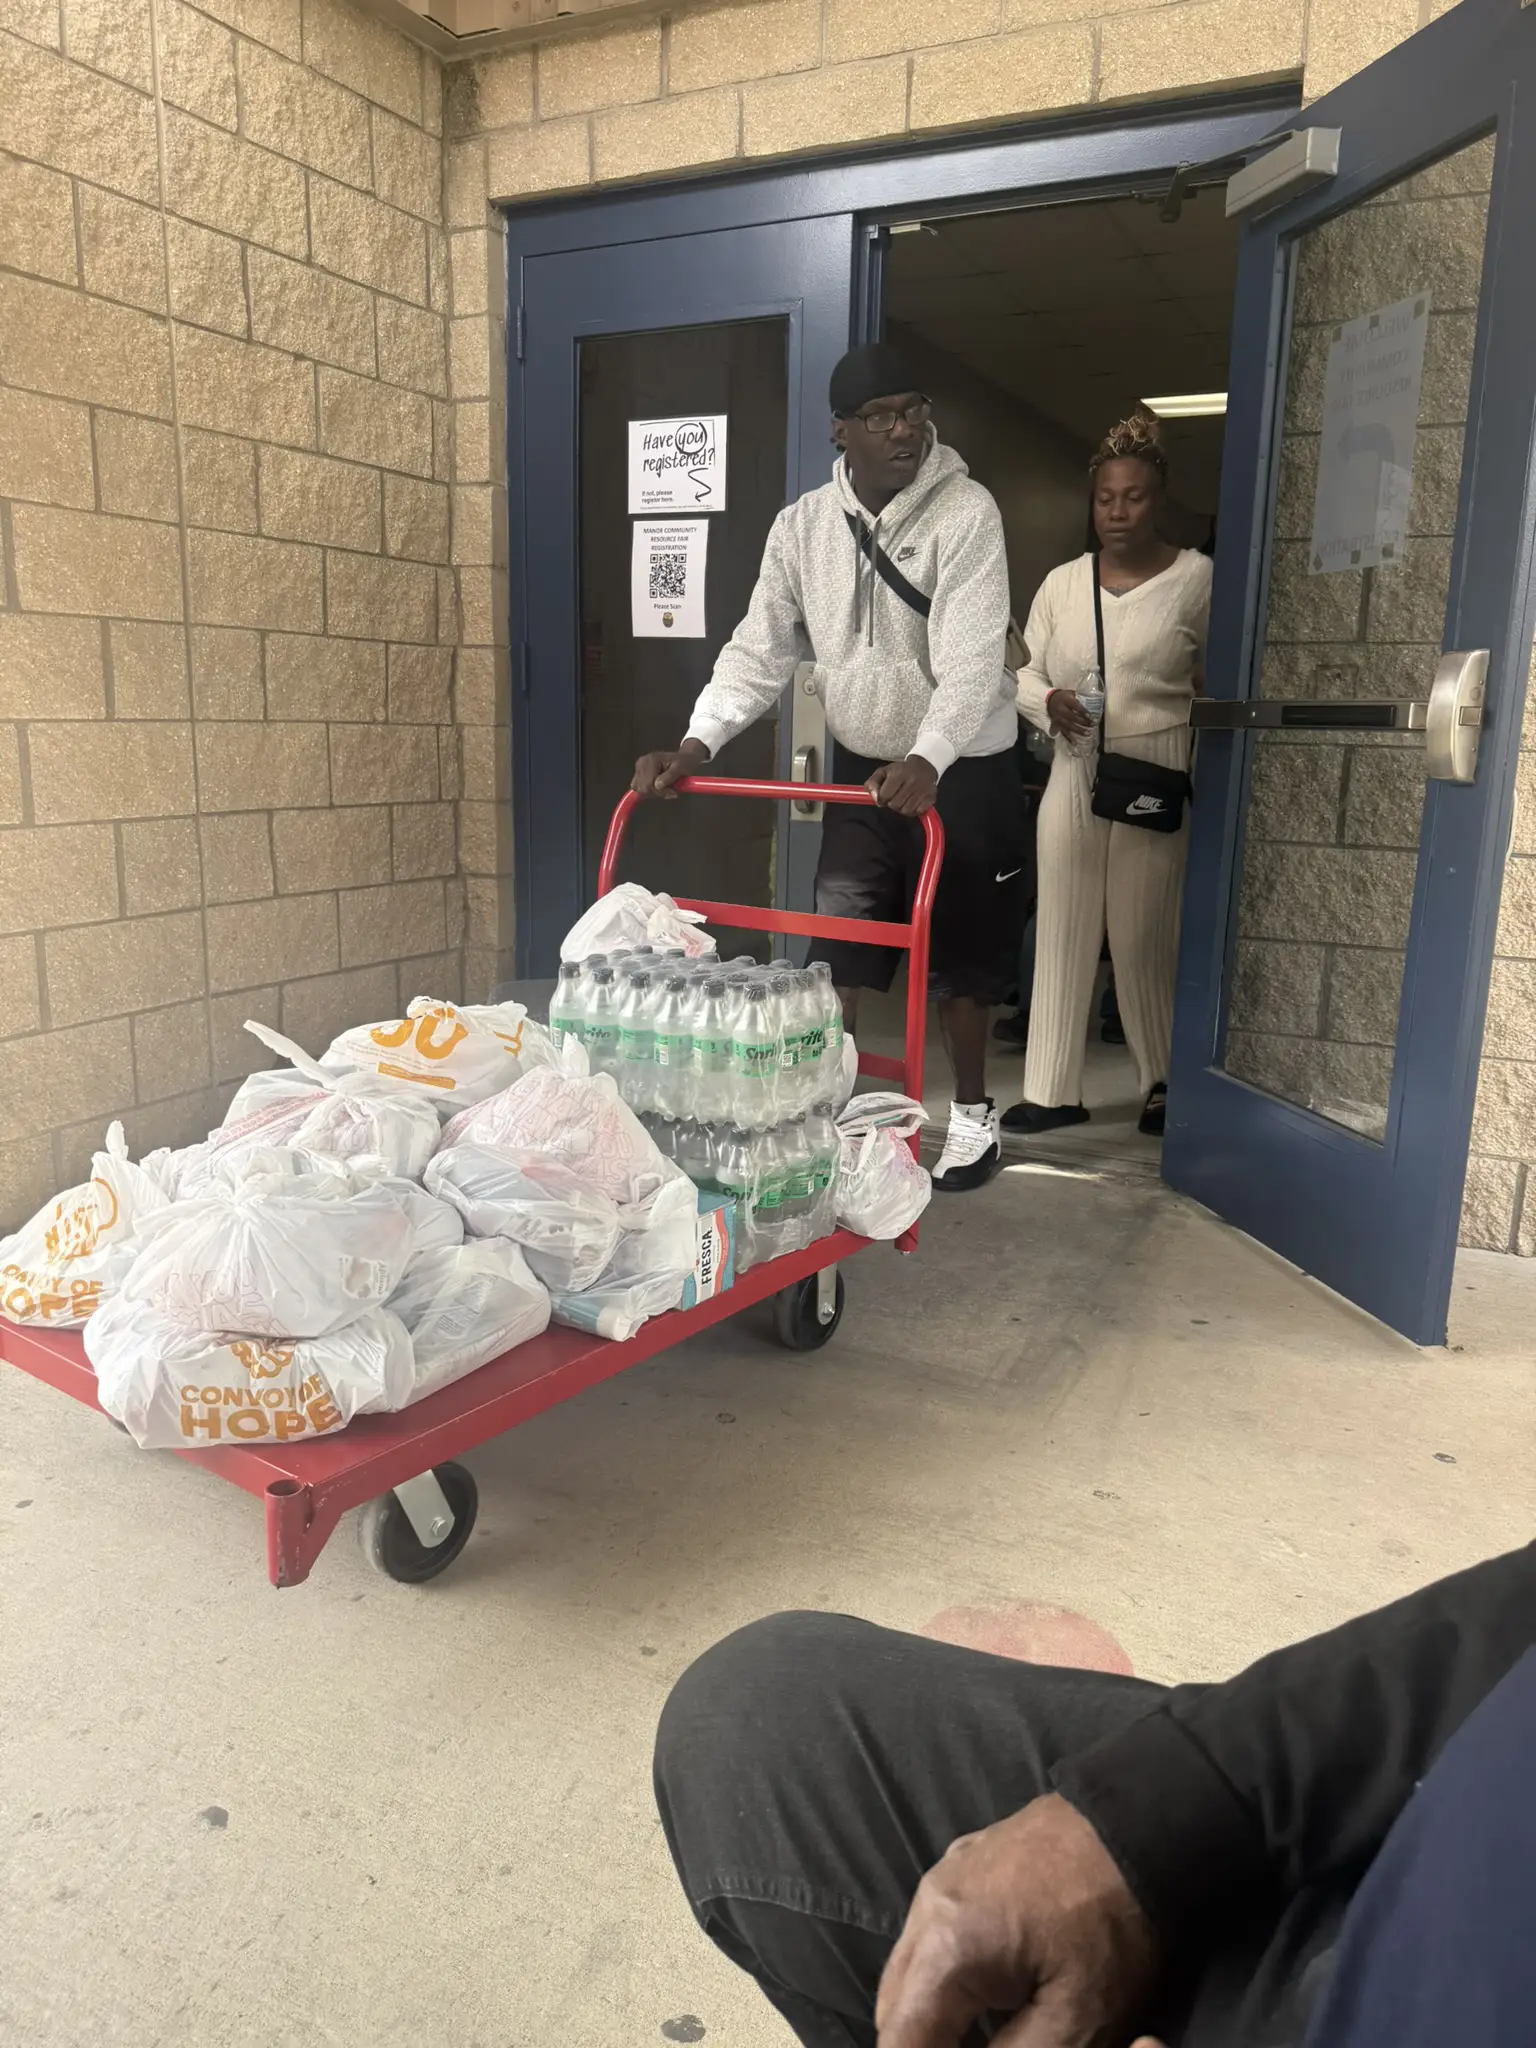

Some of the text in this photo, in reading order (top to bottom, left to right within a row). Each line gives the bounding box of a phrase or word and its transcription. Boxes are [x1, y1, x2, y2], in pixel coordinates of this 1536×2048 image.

[643, 431, 704, 453] Have you
[643, 447, 715, 478] registered?
[656, 489, 673, 497] please
[1135, 795, 1163, 809] NIKE
[702, 1230, 712, 1285] FRESCA
[71, 1279, 103, 1297] OF
[181, 1372, 323, 1409] CONVOY OF
[181, 1391, 342, 1440] HOPE
